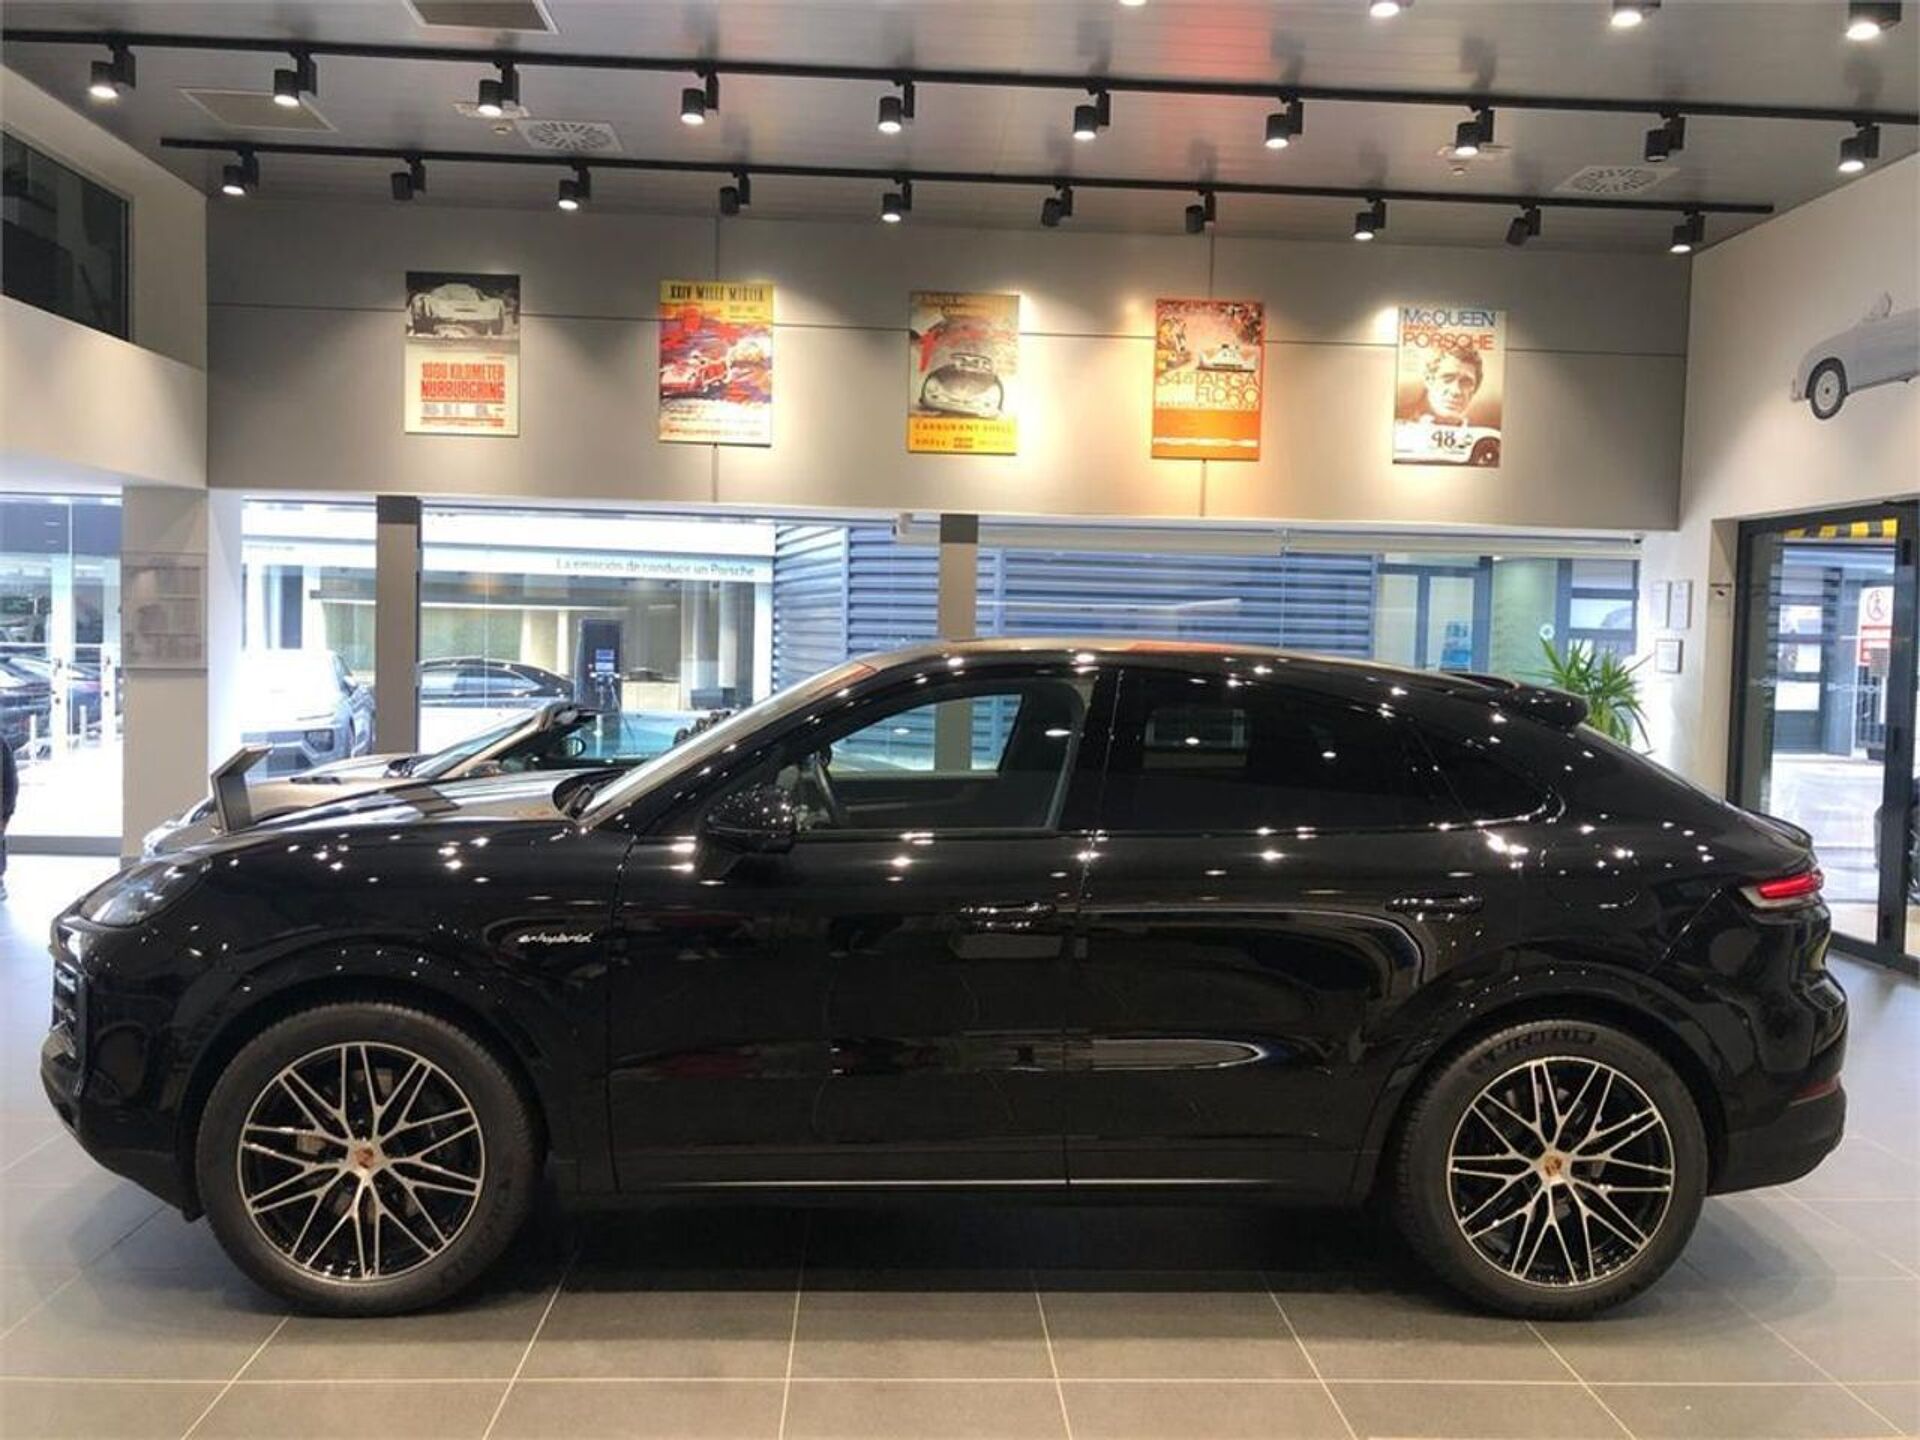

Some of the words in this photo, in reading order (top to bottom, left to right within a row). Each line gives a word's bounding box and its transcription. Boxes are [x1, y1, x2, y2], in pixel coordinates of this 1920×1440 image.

[696, 286, 724, 301] MILLE
[1403, 332, 1494, 350] PORSCHE
[711, 563, 755, 576] Porsche
